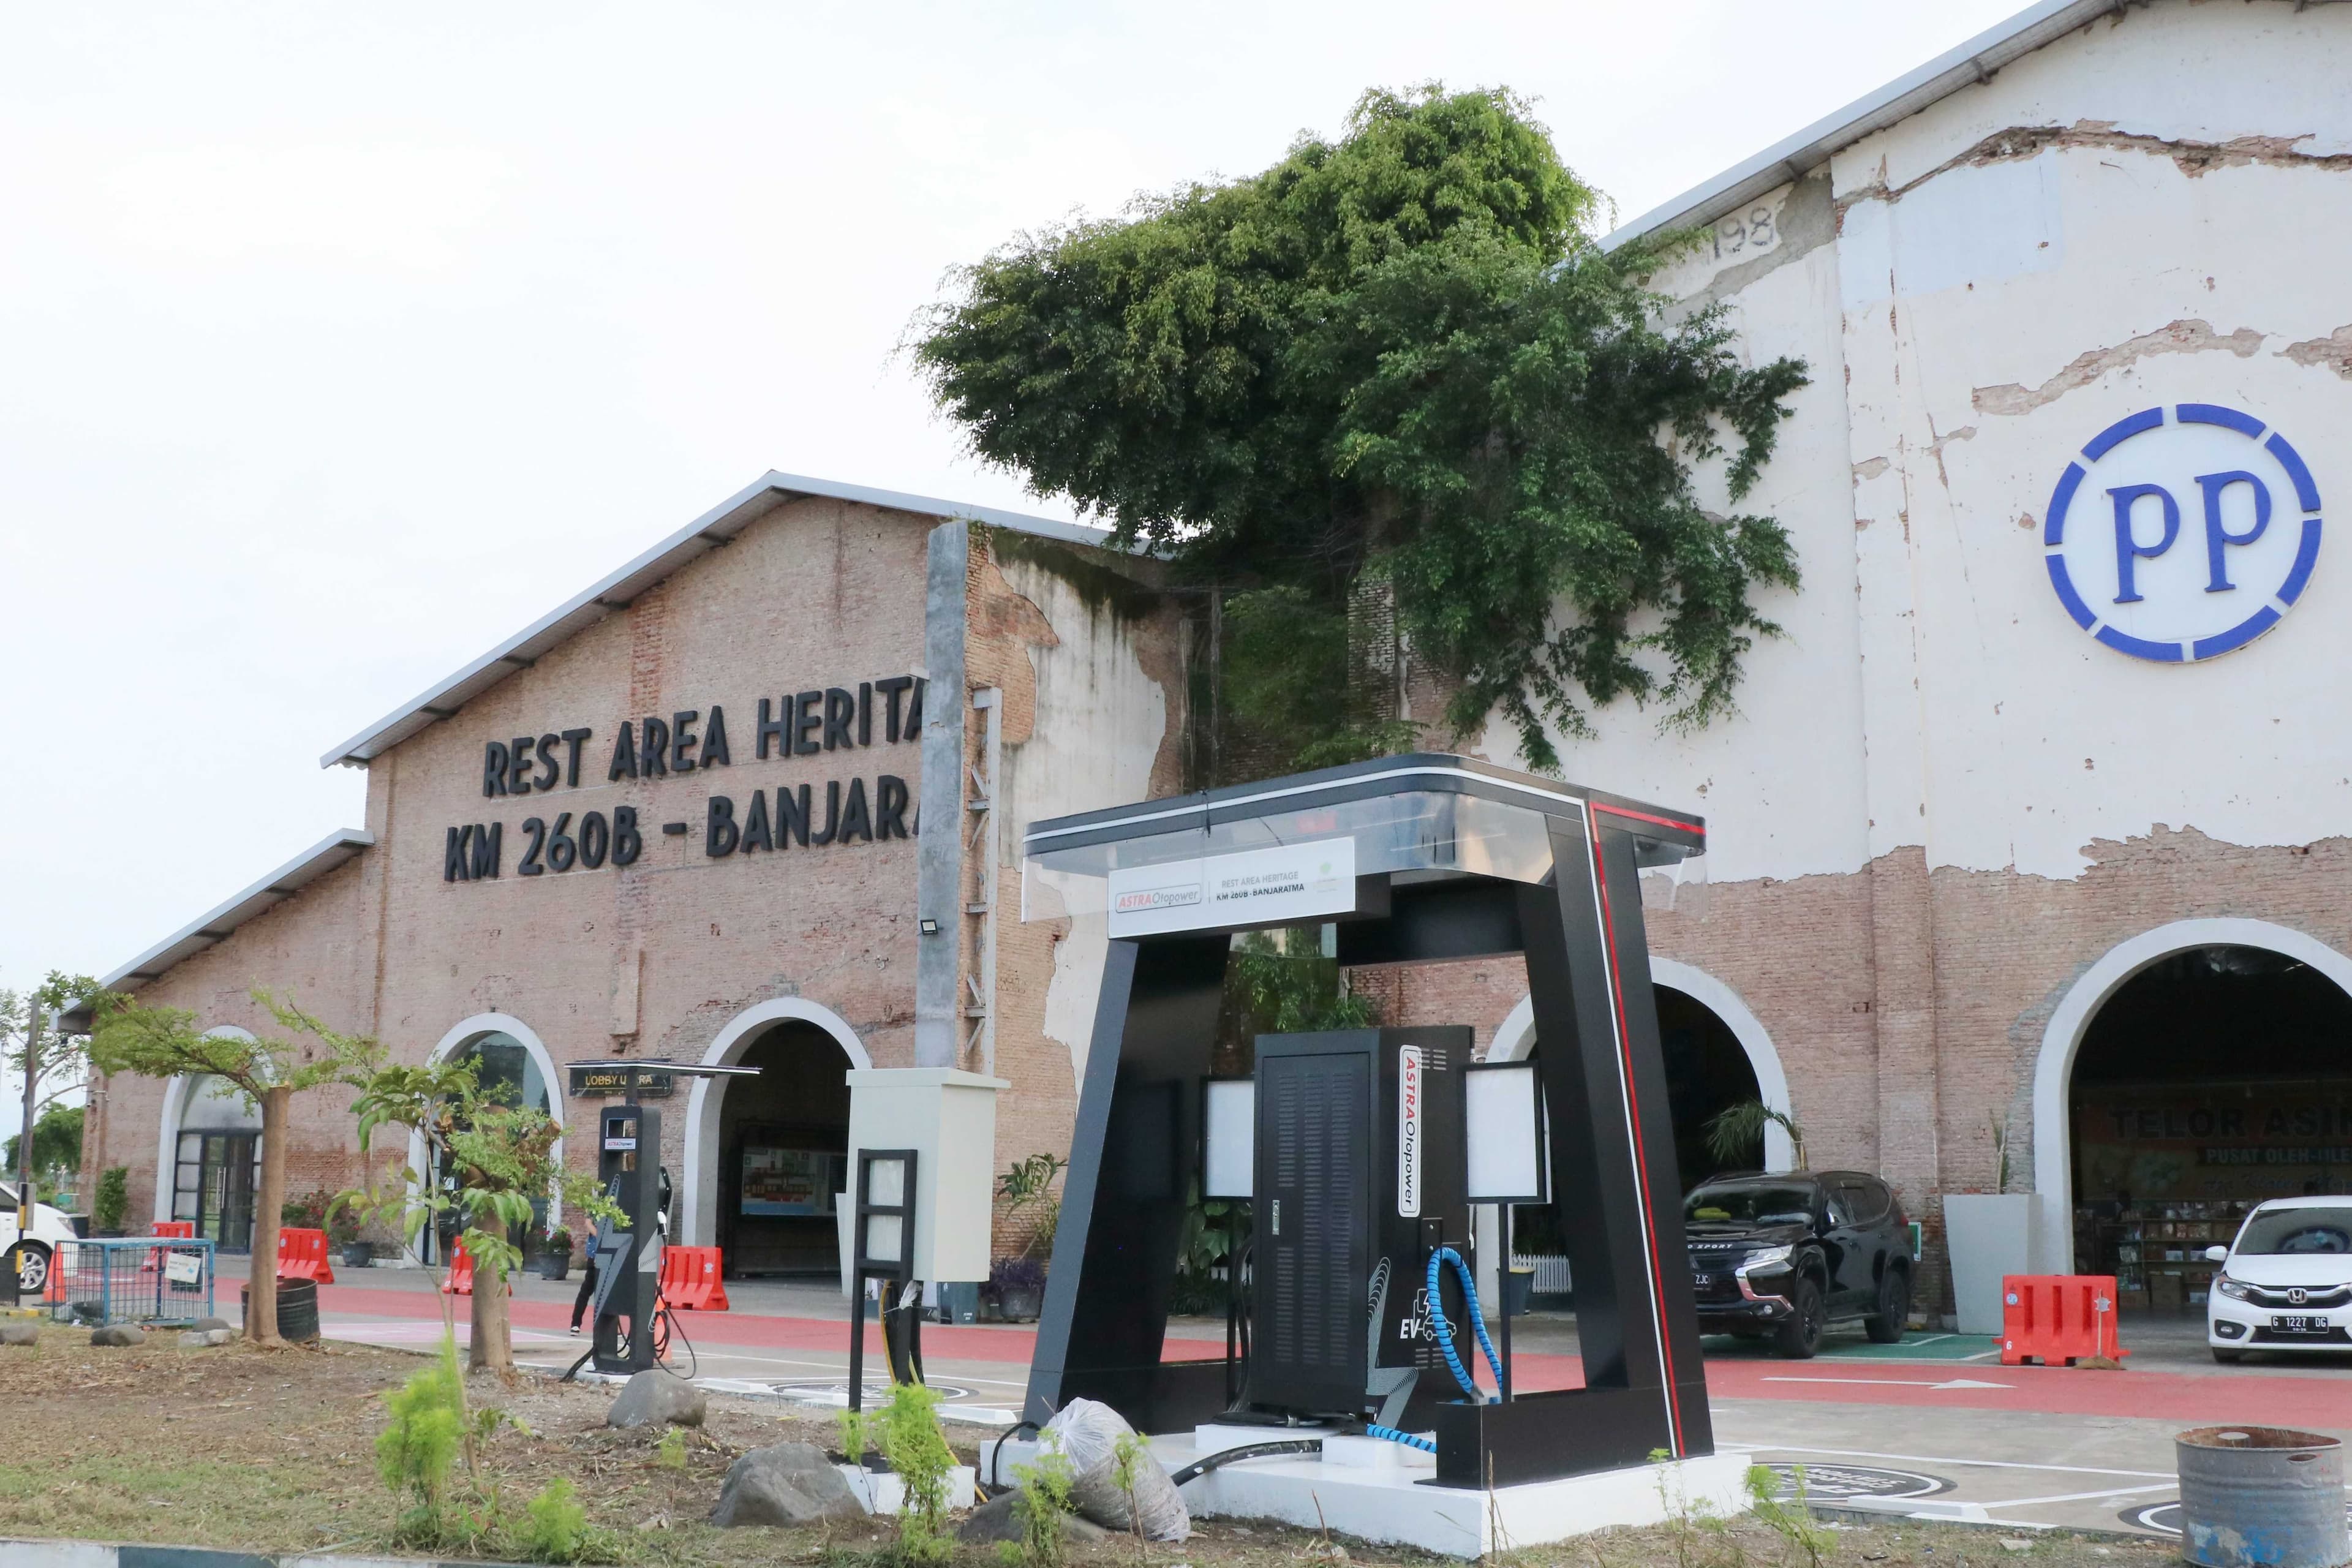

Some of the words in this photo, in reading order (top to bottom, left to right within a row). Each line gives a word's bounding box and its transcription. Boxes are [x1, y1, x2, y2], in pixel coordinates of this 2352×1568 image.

[2106, 470, 2273, 603] PP
[483, 728, 592, 798] REST
[608, 706, 730, 782] AREA
[445, 822, 502, 883] KM
[518, 805, 643, 876] 260B
[706, 774, 919, 859] BANJAR
[1222, 878, 1238, 888] REST
[1241, 876, 1261, 886] AREA
[1262, 872, 1299, 883] HERITAGE
[1216, 892, 1228, 901] KM
[1253, 883, 1305, 897] BANJARATMA
[586, 1075, 617, 1085] LOBBY
[620, 1074, 652, 1085] URA
[2108, 1106, 2246, 1139] TELOR
[2206, 1148, 2260, 1163] PUSAT
[1695, 1275, 1708, 1284] ZJC
[1400, 1319, 1421, 1339] EV
[2272, 1317, 2278, 1327] G
[2286, 1317, 2307, 1327] 1227
